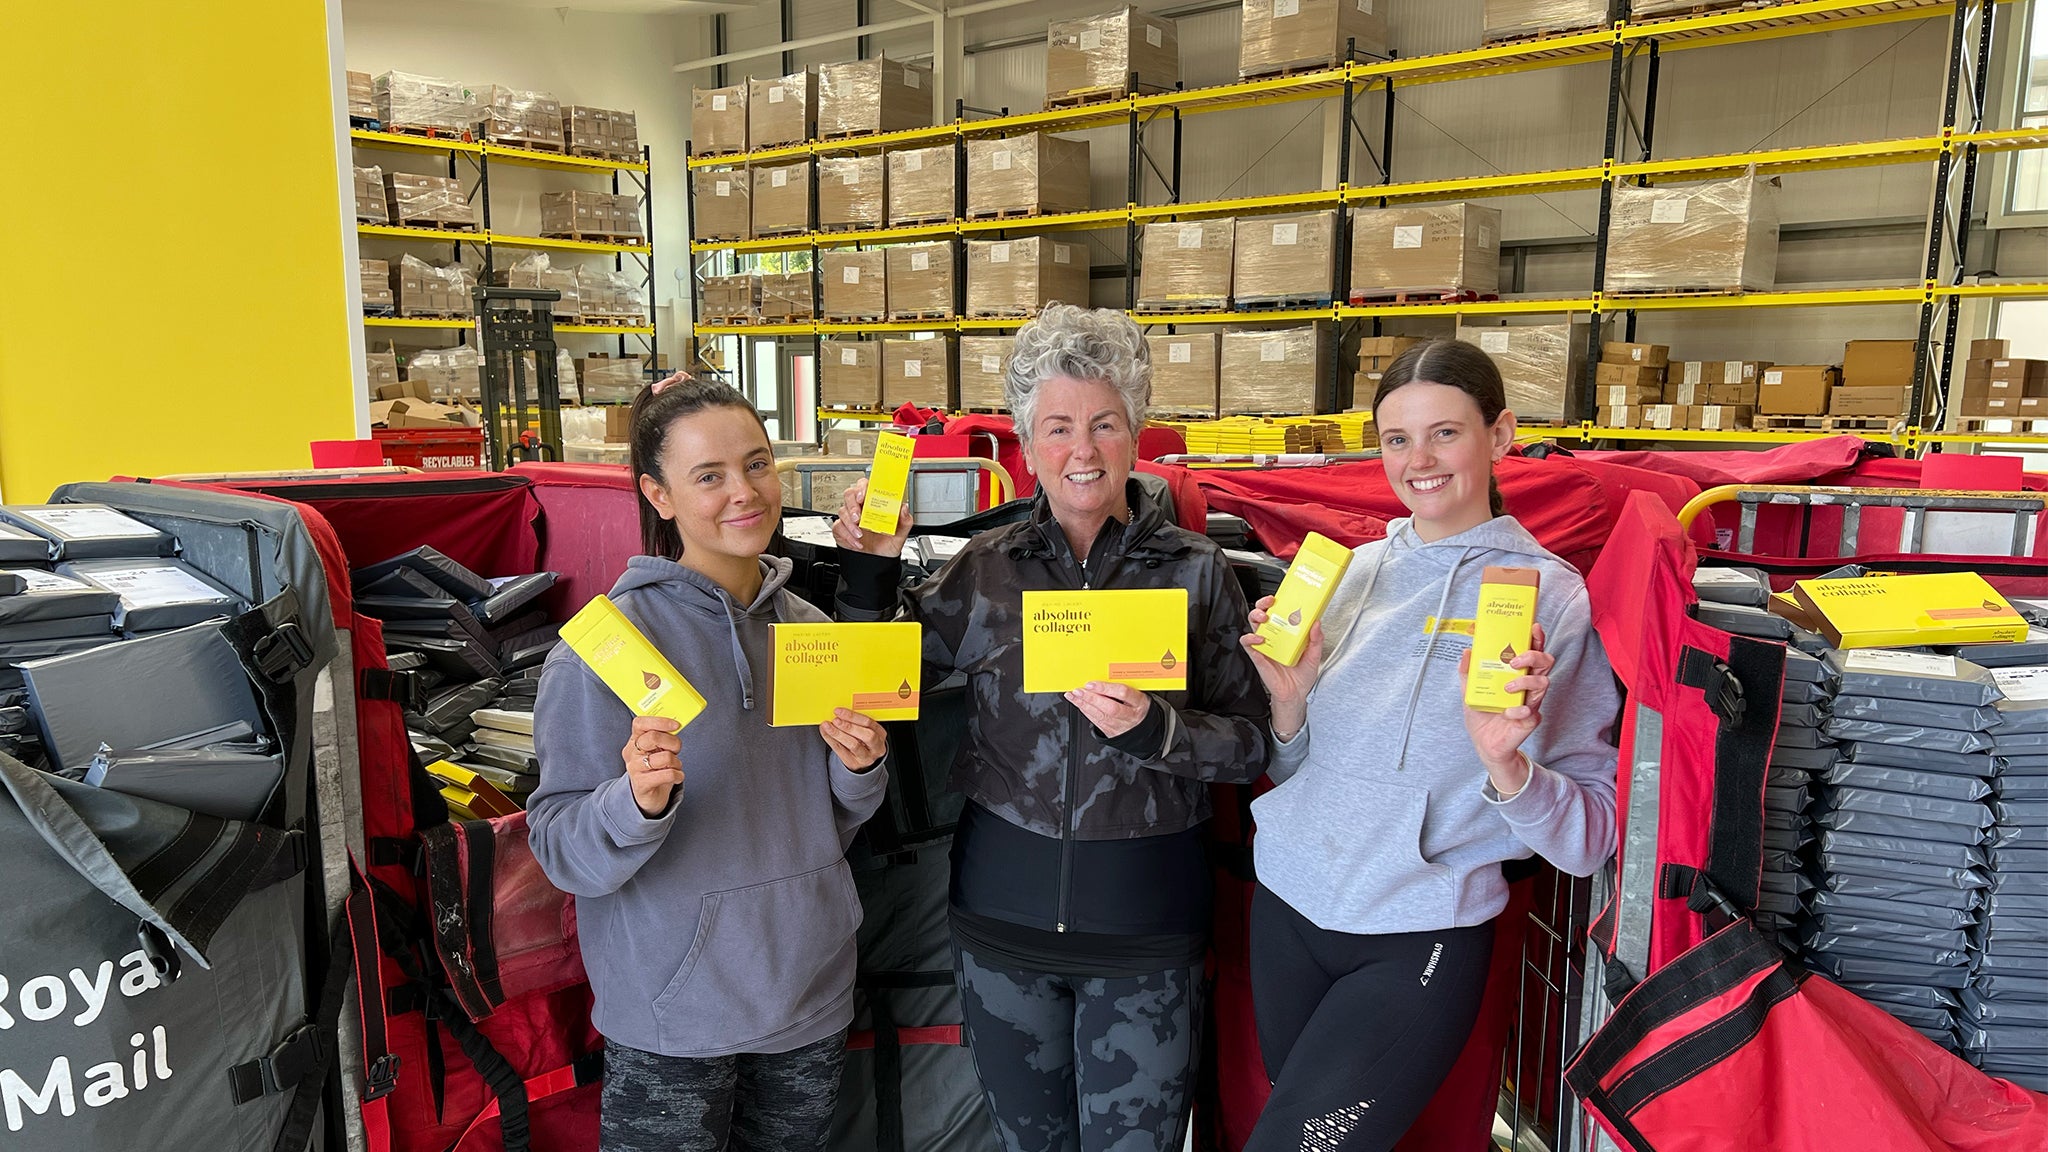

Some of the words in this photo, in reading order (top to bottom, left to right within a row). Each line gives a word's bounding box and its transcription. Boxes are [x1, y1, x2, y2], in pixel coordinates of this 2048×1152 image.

[880, 441, 911, 453] absolute
[879, 448, 909, 460] collagen
[422, 455, 475, 468] RECYCLABLES
[1816, 583, 1880, 591] absolute
[1486, 601, 1525, 610] absolute
[1033, 609, 1092, 621] absolute
[1486, 608, 1523, 617] collagen
[1033, 622, 1091, 636] collagen
[785, 639, 839, 651] absolute
[785, 652, 839, 667] collagen
[1422, 942, 1444, 978] GYMSHARK
[0, 938, 181, 1030] oya
[0, 1025, 173, 1132] Mail
